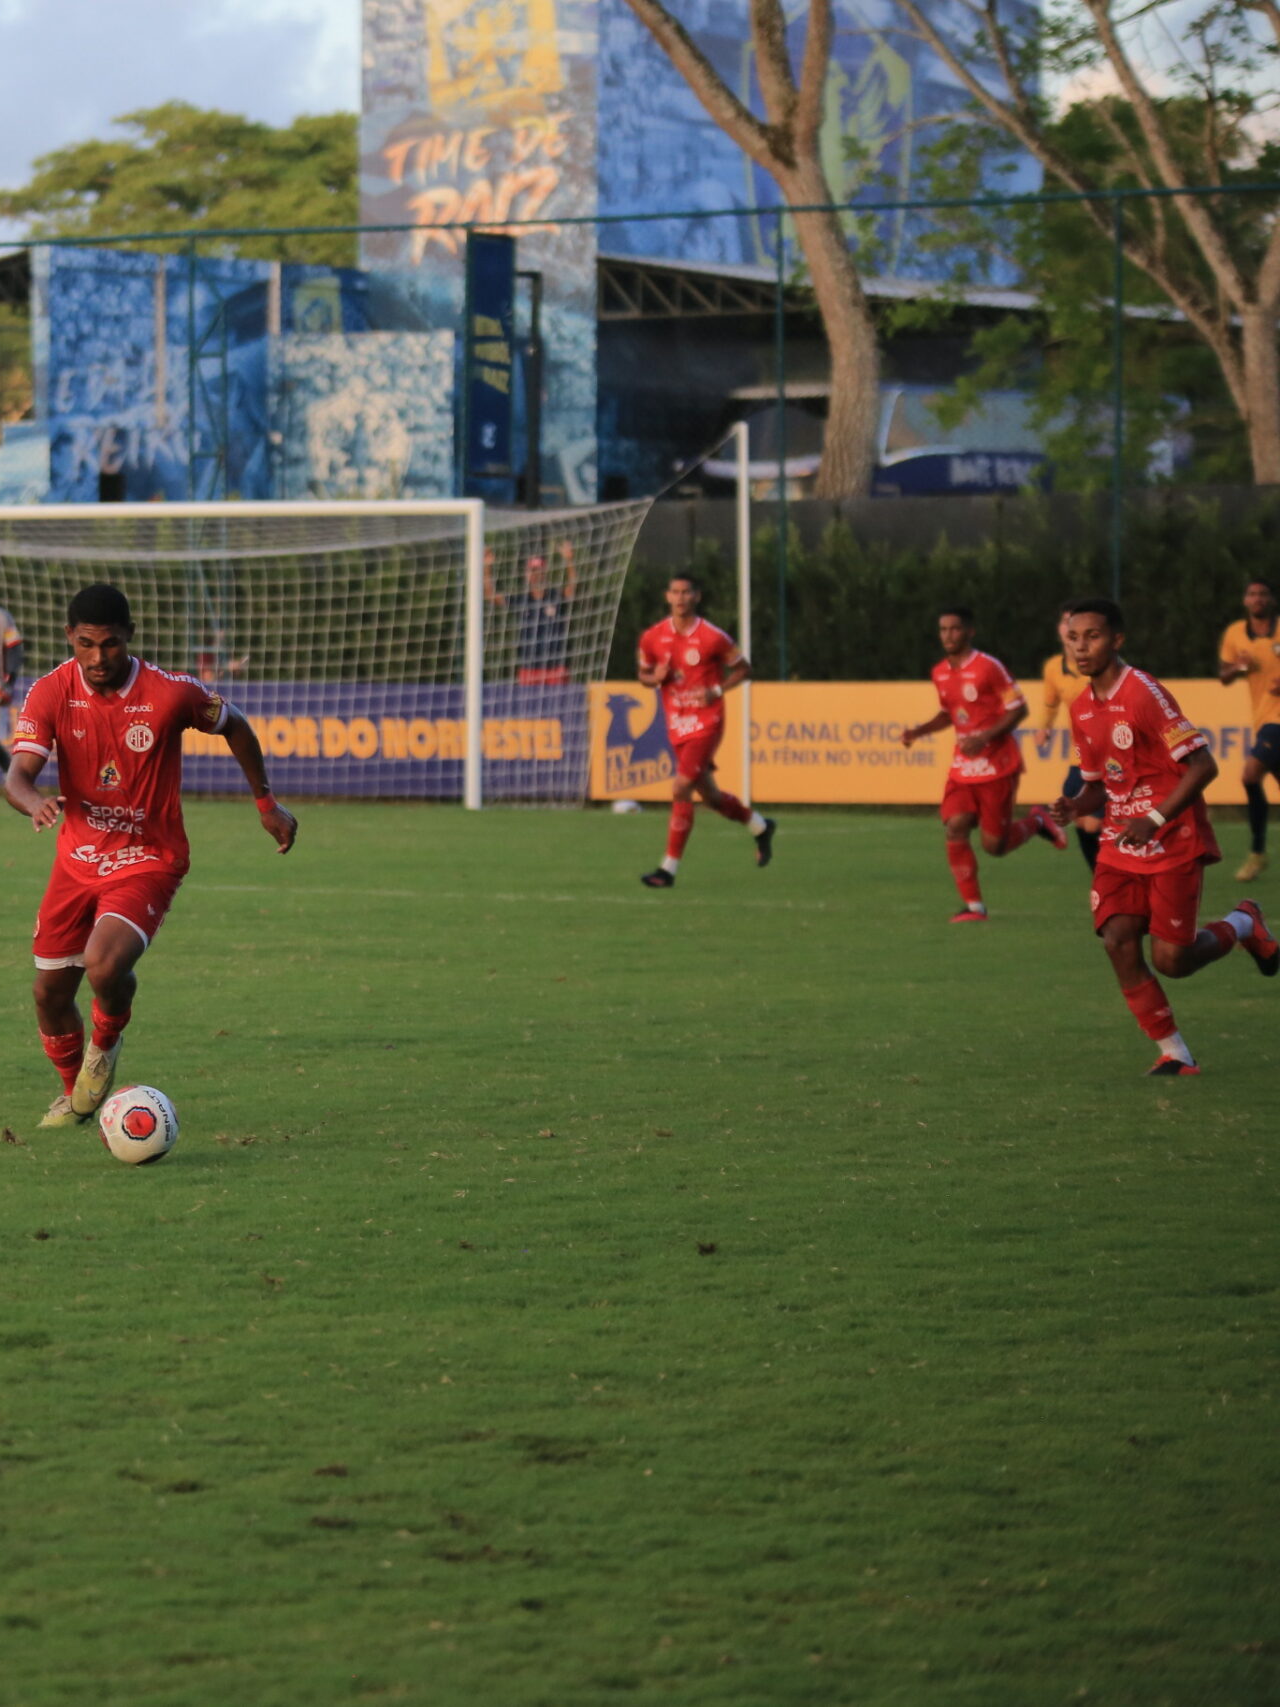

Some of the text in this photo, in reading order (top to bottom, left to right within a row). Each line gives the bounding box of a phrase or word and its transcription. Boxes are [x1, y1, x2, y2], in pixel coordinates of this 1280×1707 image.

[384, 109, 575, 186] TIME DE
[322, 717, 379, 760] DO
[766, 722, 840, 743] CANAL
[847, 721, 935, 744] OFIC
[606, 744, 634, 772] TV
[772, 744, 820, 767] FÊNIX
[826, 748, 852, 767] NO
[856, 748, 936, 767] YOUTUBE
[608, 753, 673, 792] RETRÔ
[106, 818, 144, 835] Sore
